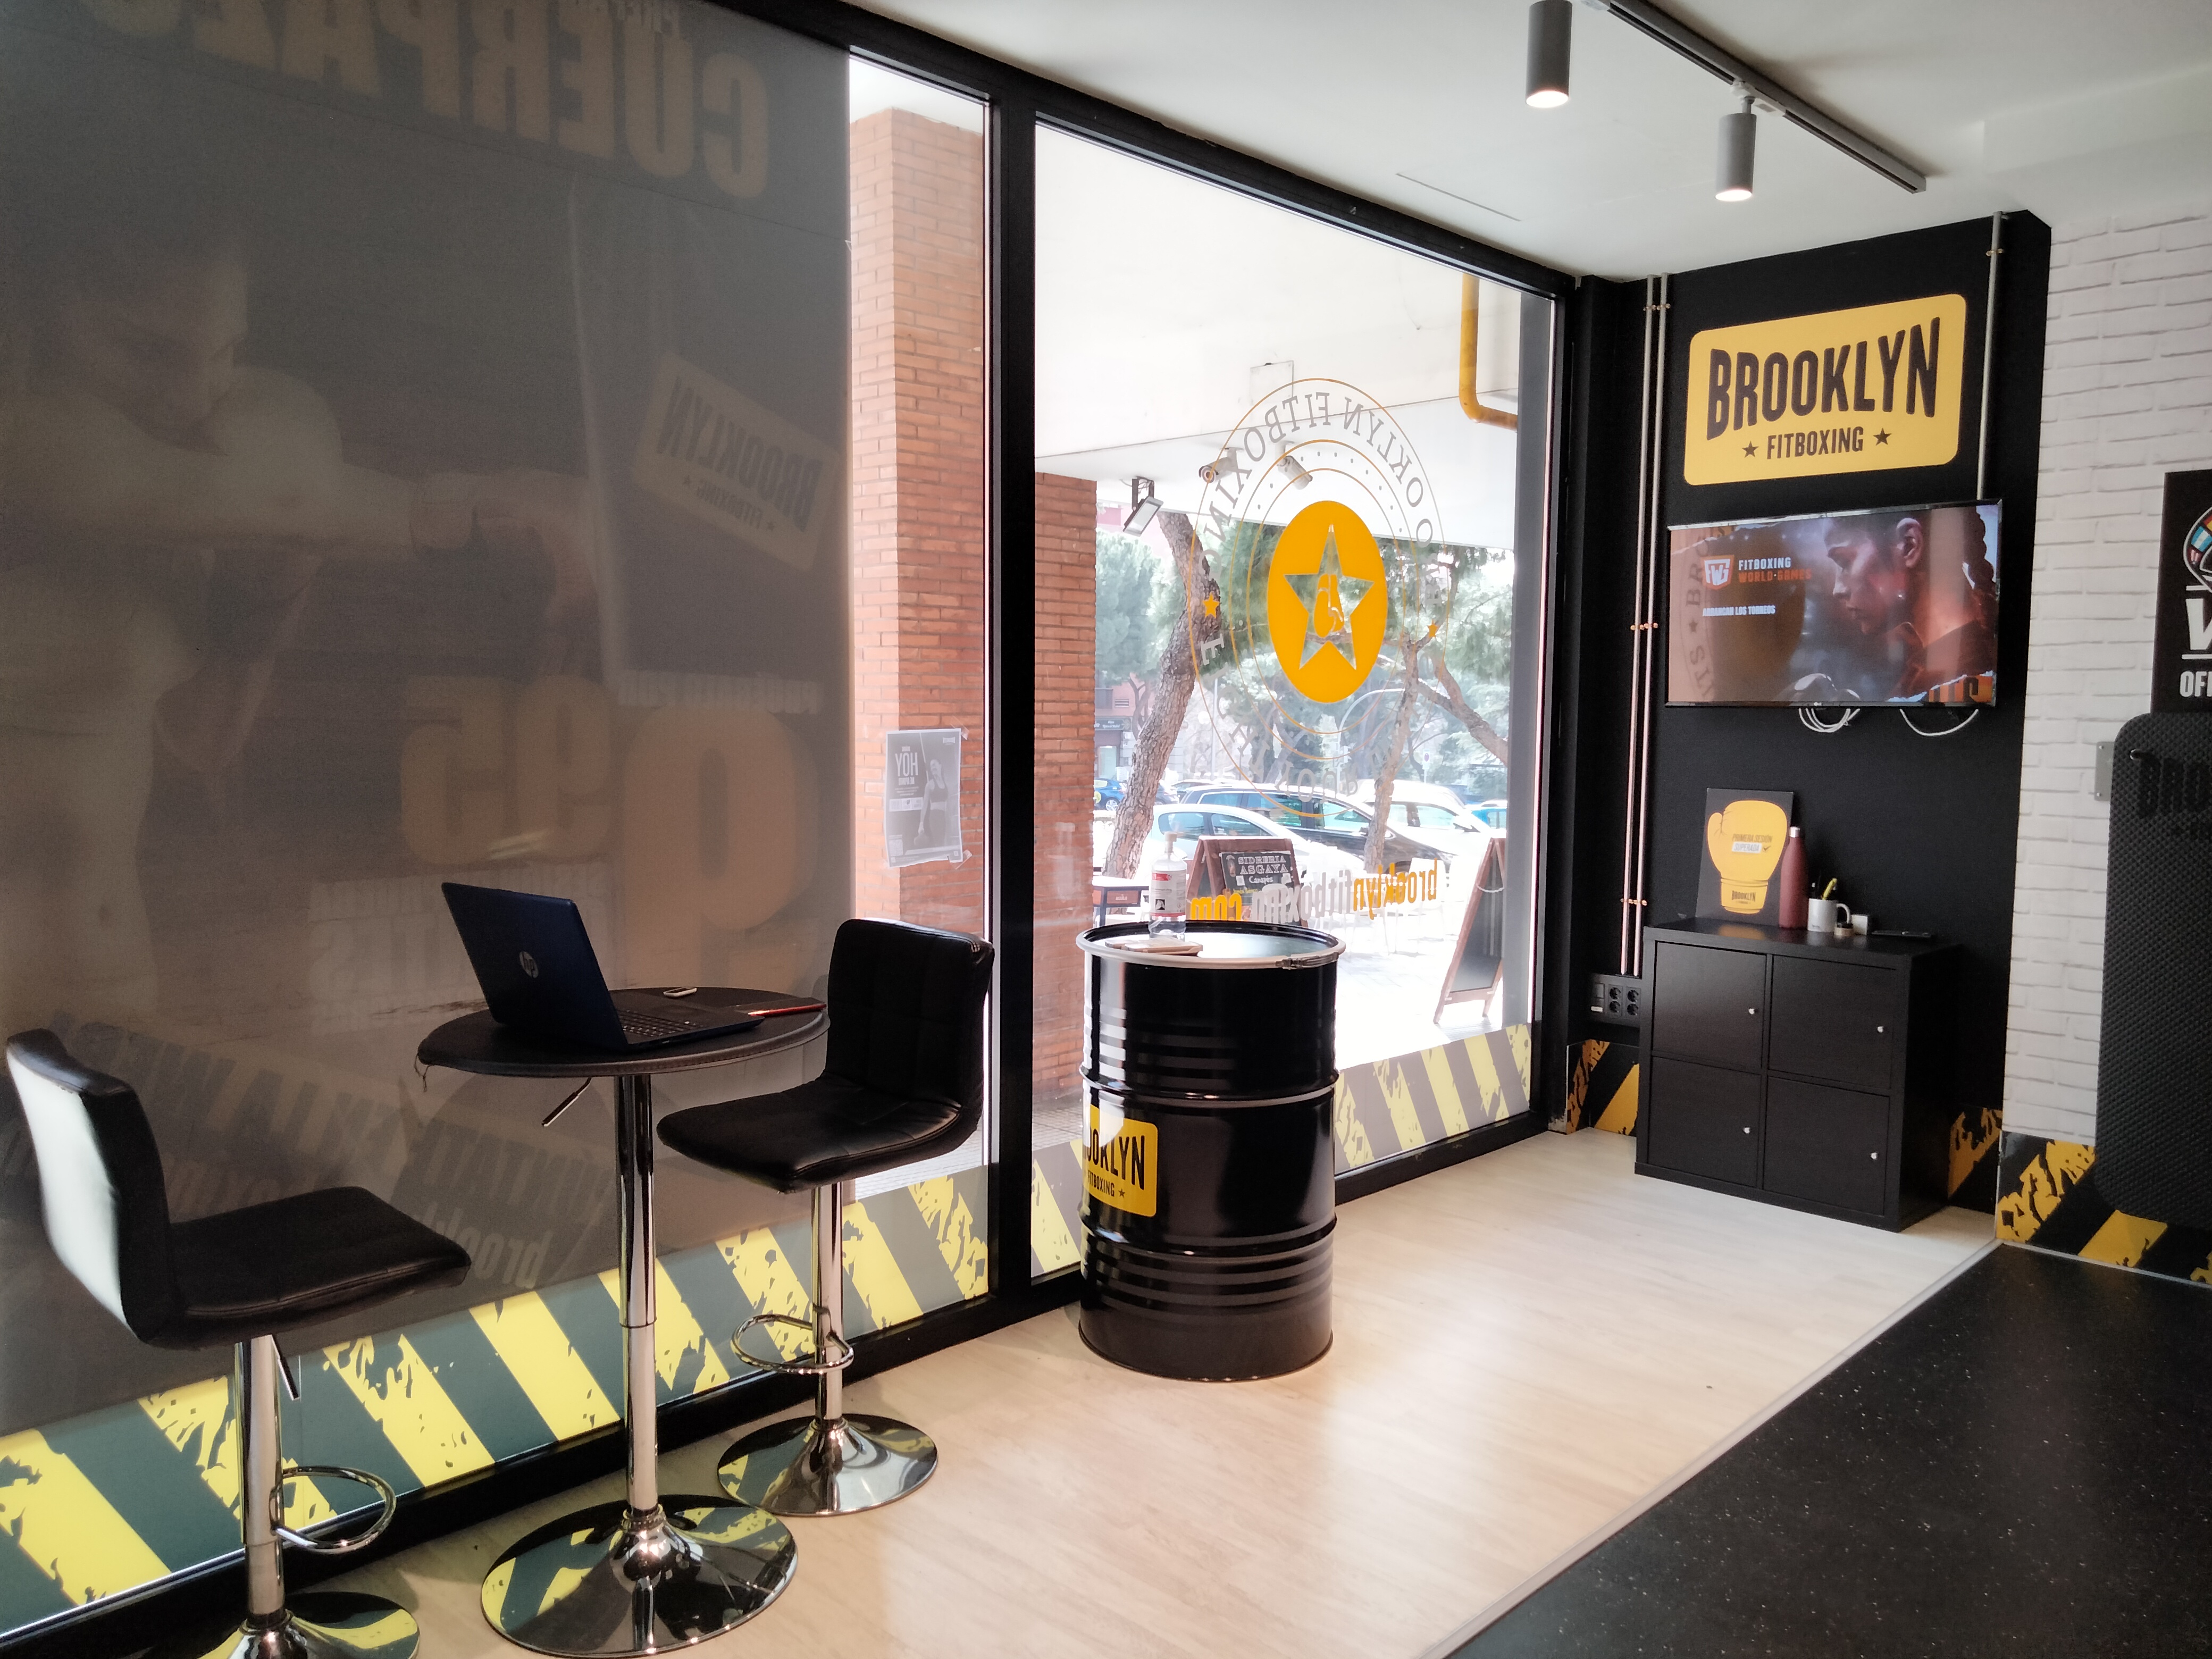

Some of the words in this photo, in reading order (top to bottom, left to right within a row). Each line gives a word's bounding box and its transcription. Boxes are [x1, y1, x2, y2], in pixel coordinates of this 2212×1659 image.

[1706, 316, 1940, 441] BROOKLYN
[1767, 426, 1864, 459] FITBOXING
[1738, 557, 1791, 571] FITBOXING
[1738, 570, 1773, 583] WORLD
[1735, 606, 1747, 615] LOS
[2180, 671, 2212, 697] OF
[1734, 843, 1759, 852] SUPERADA
[1240, 864, 1289, 875] ASGAYA
[1732, 891, 1756, 902] BROOKLYN
